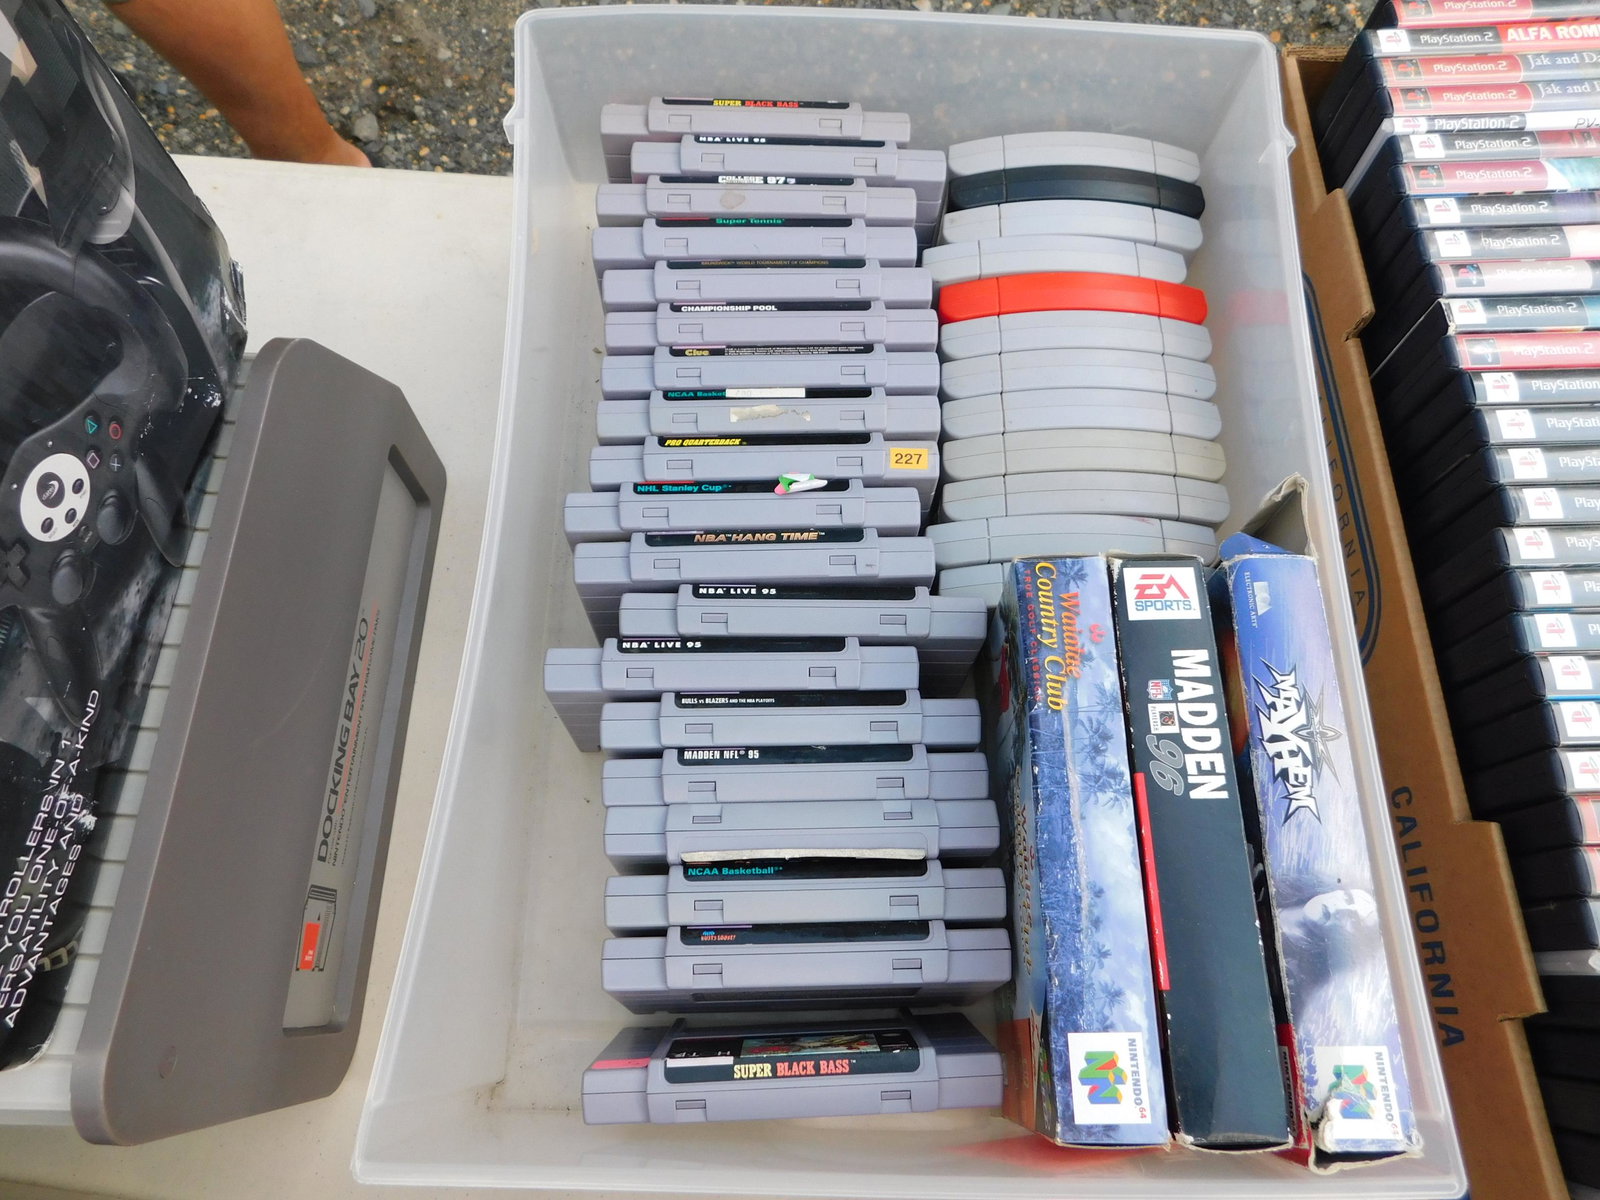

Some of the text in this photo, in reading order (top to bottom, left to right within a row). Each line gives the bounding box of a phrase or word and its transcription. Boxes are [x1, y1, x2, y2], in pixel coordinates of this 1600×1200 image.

[1444, 0, 1505, 10] PlayStation
[1419, 33, 1480, 45] PlayStation
[1507, 26, 1552, 41] ALFA
[1433, 63, 1494, 74] PlayStation
[1526, 55, 1551, 70] Jak
[1555, 53, 1580, 65] and
[1443, 91, 1505, 103] PlayStation
[1538, 83, 1562, 99] Jak
[1566, 82, 1591, 94] and
[1434, 118, 1505, 134] PlayStation
[1455, 137, 1520, 151] PlayStation
[767, 176, 786, 184] 97
[1456, 168, 1520, 180] PlayStation
[1471, 201, 1536, 216] PlayStation
[1482, 234, 1547, 250] PlayStation
[1496, 303, 1564, 318] PlayStation
[895, 453, 922, 464] 227
[701, 484, 722, 492] Cup
[694, 532, 819, 543] NBA HANG TIME
[1024, 569, 1033, 598] TRUE
[1244, 571, 1255, 610] ELECTRONIC
[1135, 599, 1193, 611] SPORTS
[1027, 603, 1037, 634] GOLF
[1035, 561, 1068, 711] Country Club
[1150, 680, 1163, 699] NFL
[1170, 649, 1230, 799] MADDEN
[317, 724, 351, 863] DOCKING
[344, 662, 360, 722] BAY
[354, 617, 368, 661] 20
[1251, 657, 1322, 827] MAYHEM
[684, 749, 759, 759] MADDEN NFL 95
[1145, 734, 1185, 796] 96
[60, 794, 83, 850] AND
[721, 867, 774, 875] Basketball
[0, 894, 31, 953] YOU
[1390, 785, 1466, 1048] CALIFORNIA
[733, 1059, 850, 1078] SUPER BLACK BASS
[1128, 1038, 1147, 1119] NINTENDO 64
[1282, 1051, 1294, 1119] NINTENDO
[1374, 1051, 1394, 1122] NINTENDO
